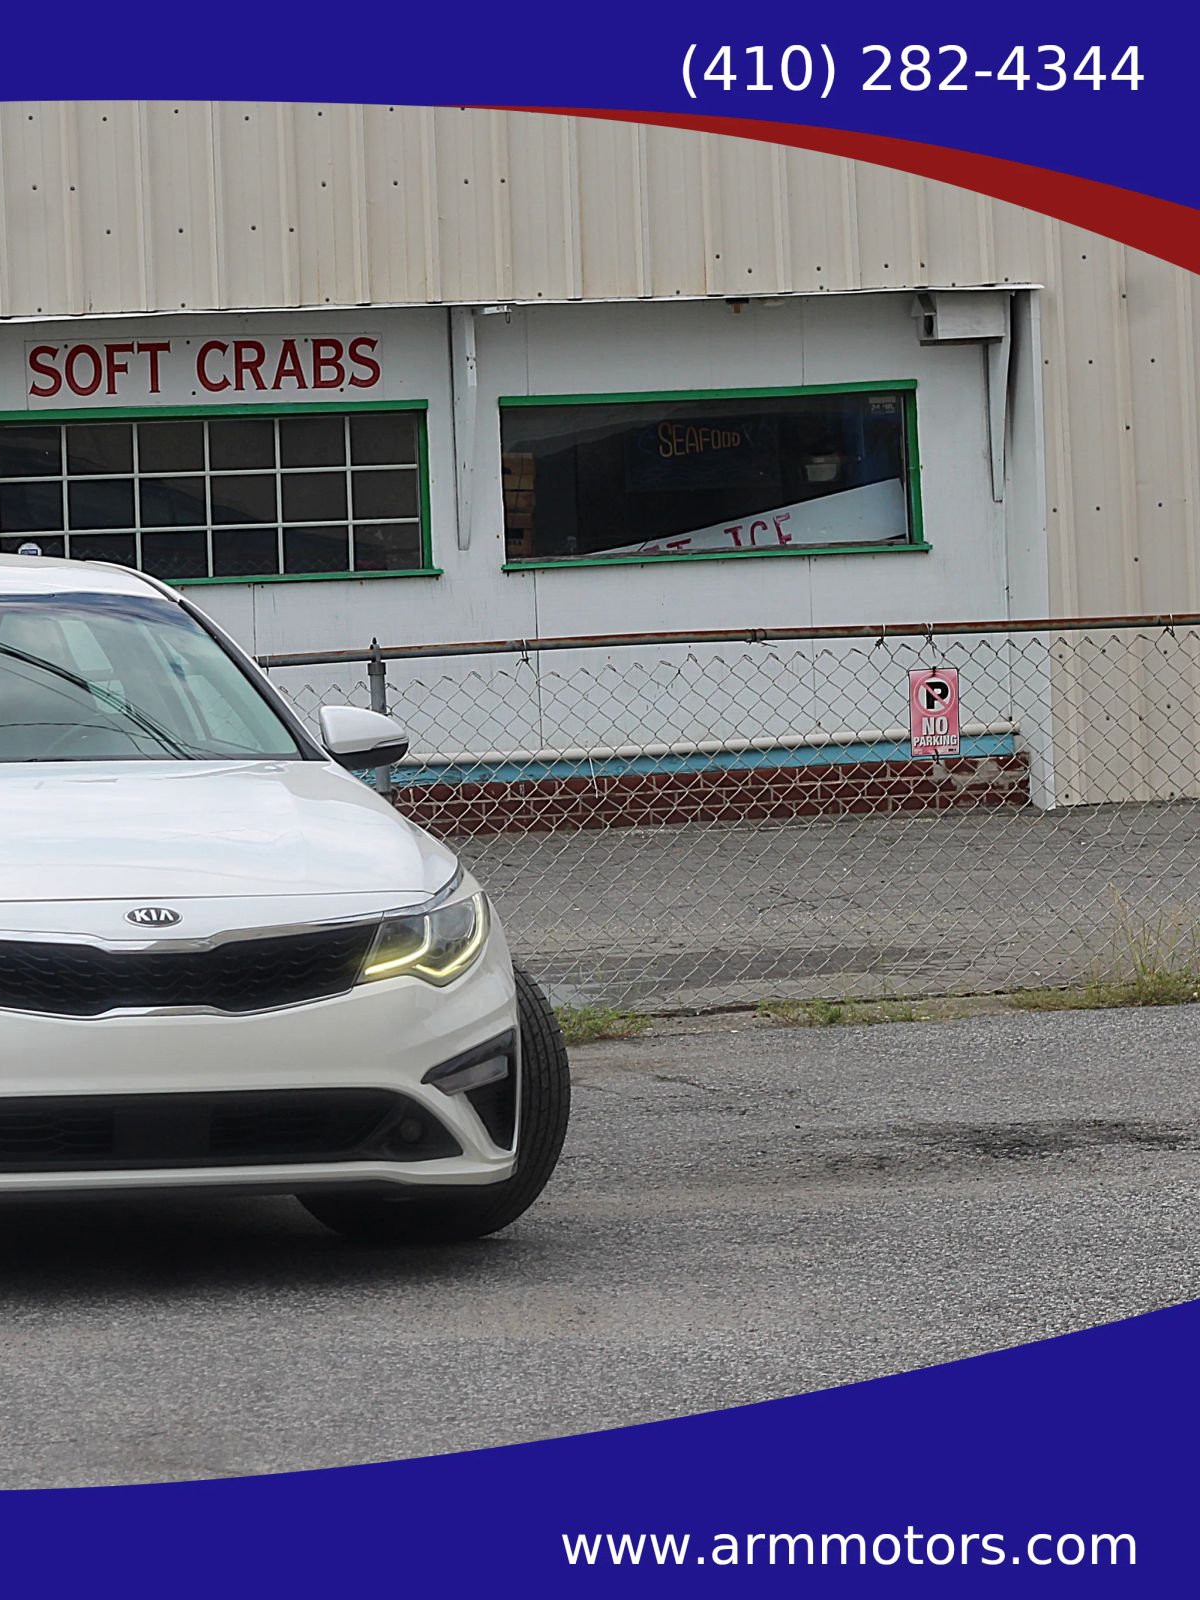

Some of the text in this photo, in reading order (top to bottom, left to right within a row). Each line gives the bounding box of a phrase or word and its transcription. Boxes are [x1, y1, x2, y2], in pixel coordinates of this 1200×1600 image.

[28, 336, 382, 398] SOFT CRABS
[657, 421, 742, 458] SEAFOOD
[921, 716, 950, 736] NO
[913, 734, 958, 748] PARKING
[134, 909, 175, 922] KIA
